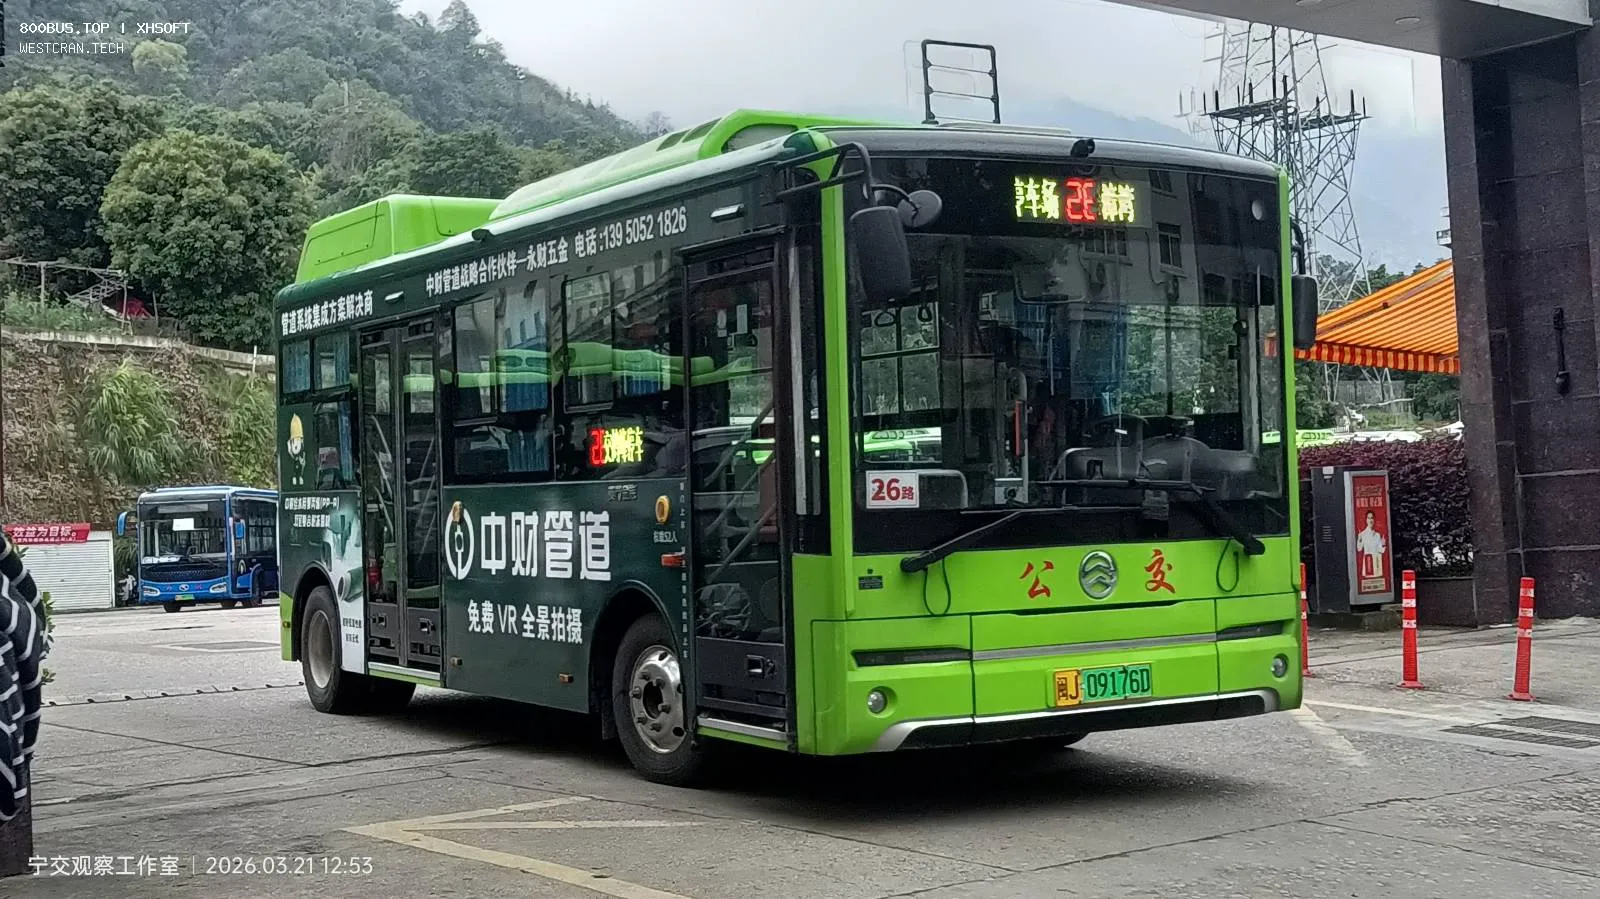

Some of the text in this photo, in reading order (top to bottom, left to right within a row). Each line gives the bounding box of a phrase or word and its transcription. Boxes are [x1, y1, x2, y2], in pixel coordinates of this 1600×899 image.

[626, 213, 654, 243] 5052
[657, 206, 687, 236] 1826
[281, 289, 373, 336] 管道系统集成方案解决商
[871, 478, 914, 501] 26路
[480, 510, 611, 581] 中财管道
[1019, 549, 1176, 598] 公 交
[467, 599, 583, 644] 免费 VR 全景拍摄
[1086, 666, 1150, 699] 09176D
